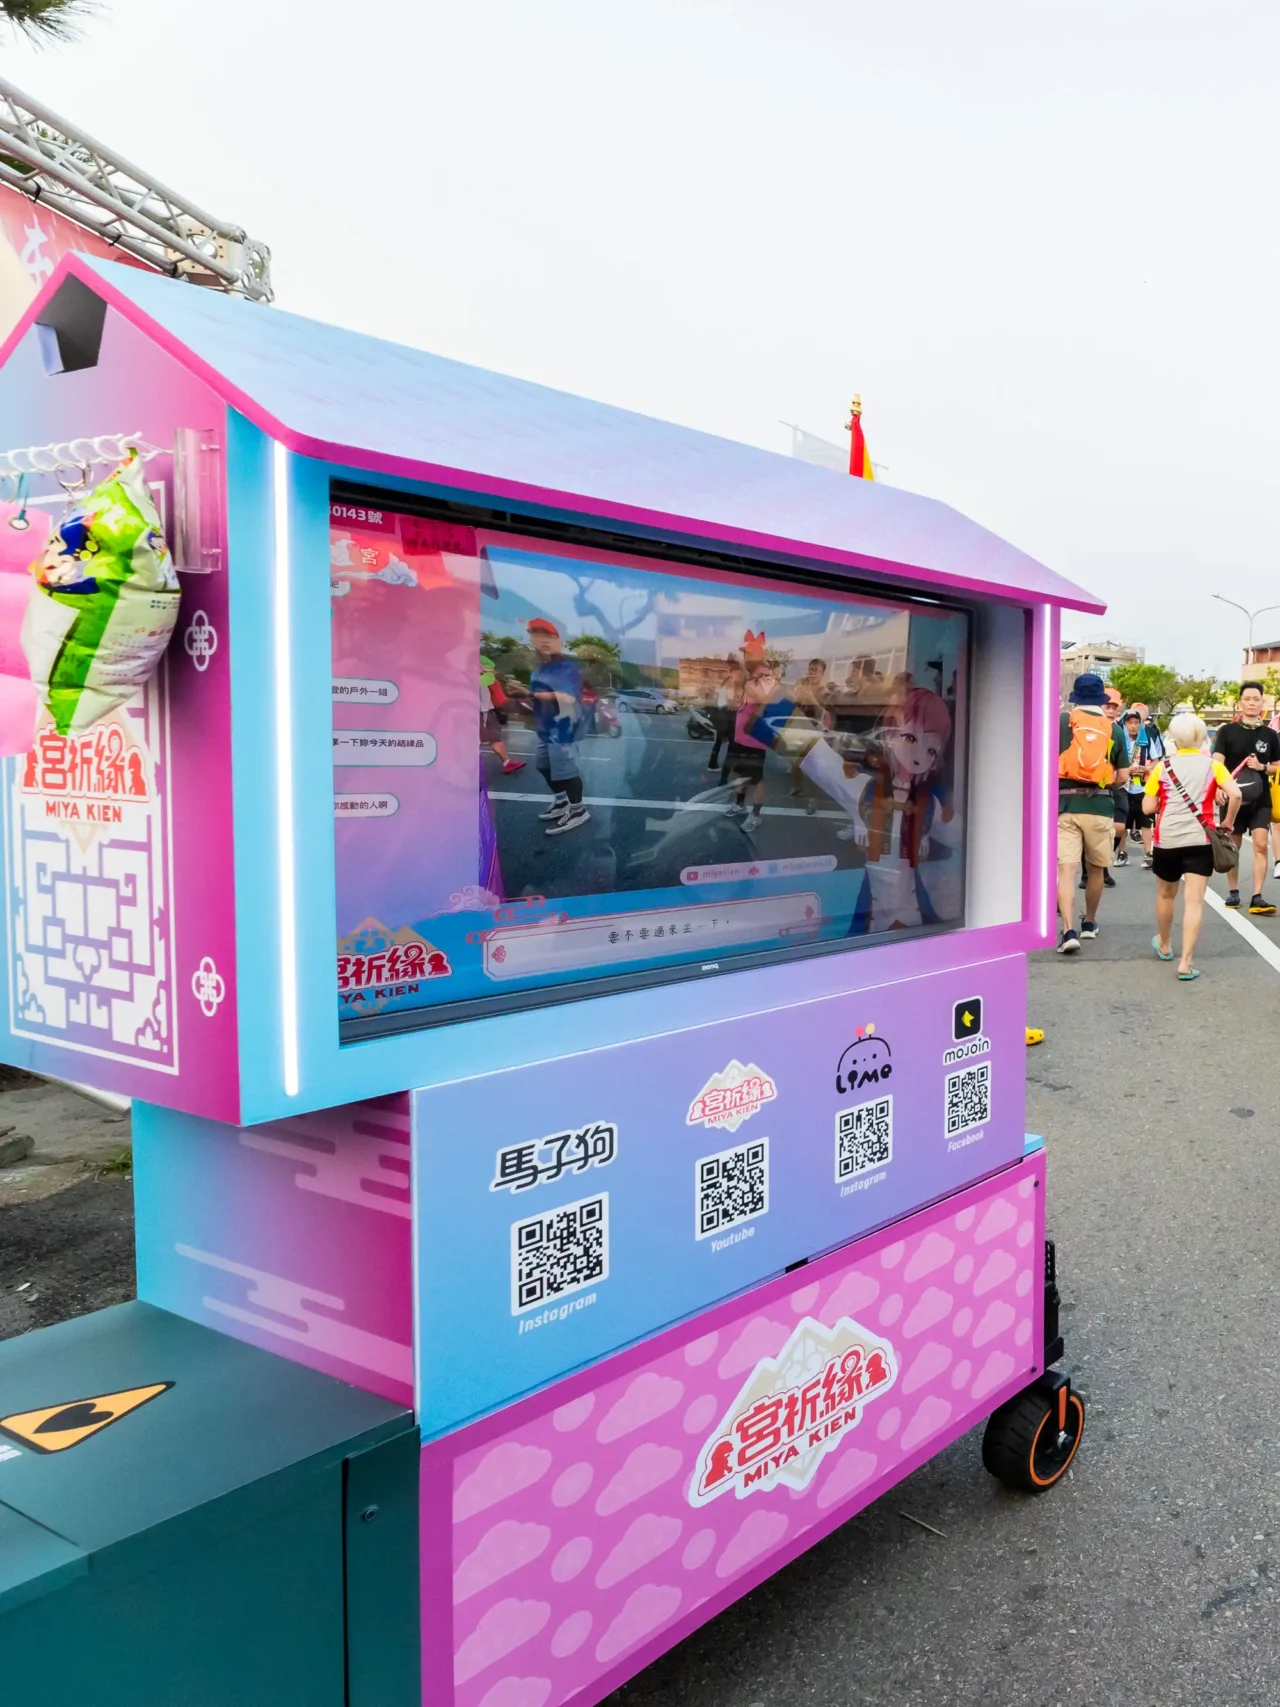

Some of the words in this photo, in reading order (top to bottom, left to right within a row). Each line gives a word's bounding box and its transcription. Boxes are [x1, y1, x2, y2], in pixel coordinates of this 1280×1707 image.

[330, 505, 382, 525] 0143號
[39, 729, 126, 794] 宮祈緣
[46, 801, 81, 820] MIYA
[87, 802, 123, 823] KIEN
[375, 984, 419, 999] KIEN
[704, 1077, 761, 1115] 宮祈緣
[707, 1112, 733, 1125] MIYA
[736, 1103, 758, 1115] KIEN
[947, 1129, 985, 1154] Facebook
[840, 1171, 886, 1198] Instagram
[711, 1226, 755, 1254] Youtube
[518, 1292, 597, 1335] Instagram
[736, 1350, 864, 1467] 宮祈緣
[743, 1445, 799, 1488] MIYA
[808, 1407, 856, 1447] KIEN
